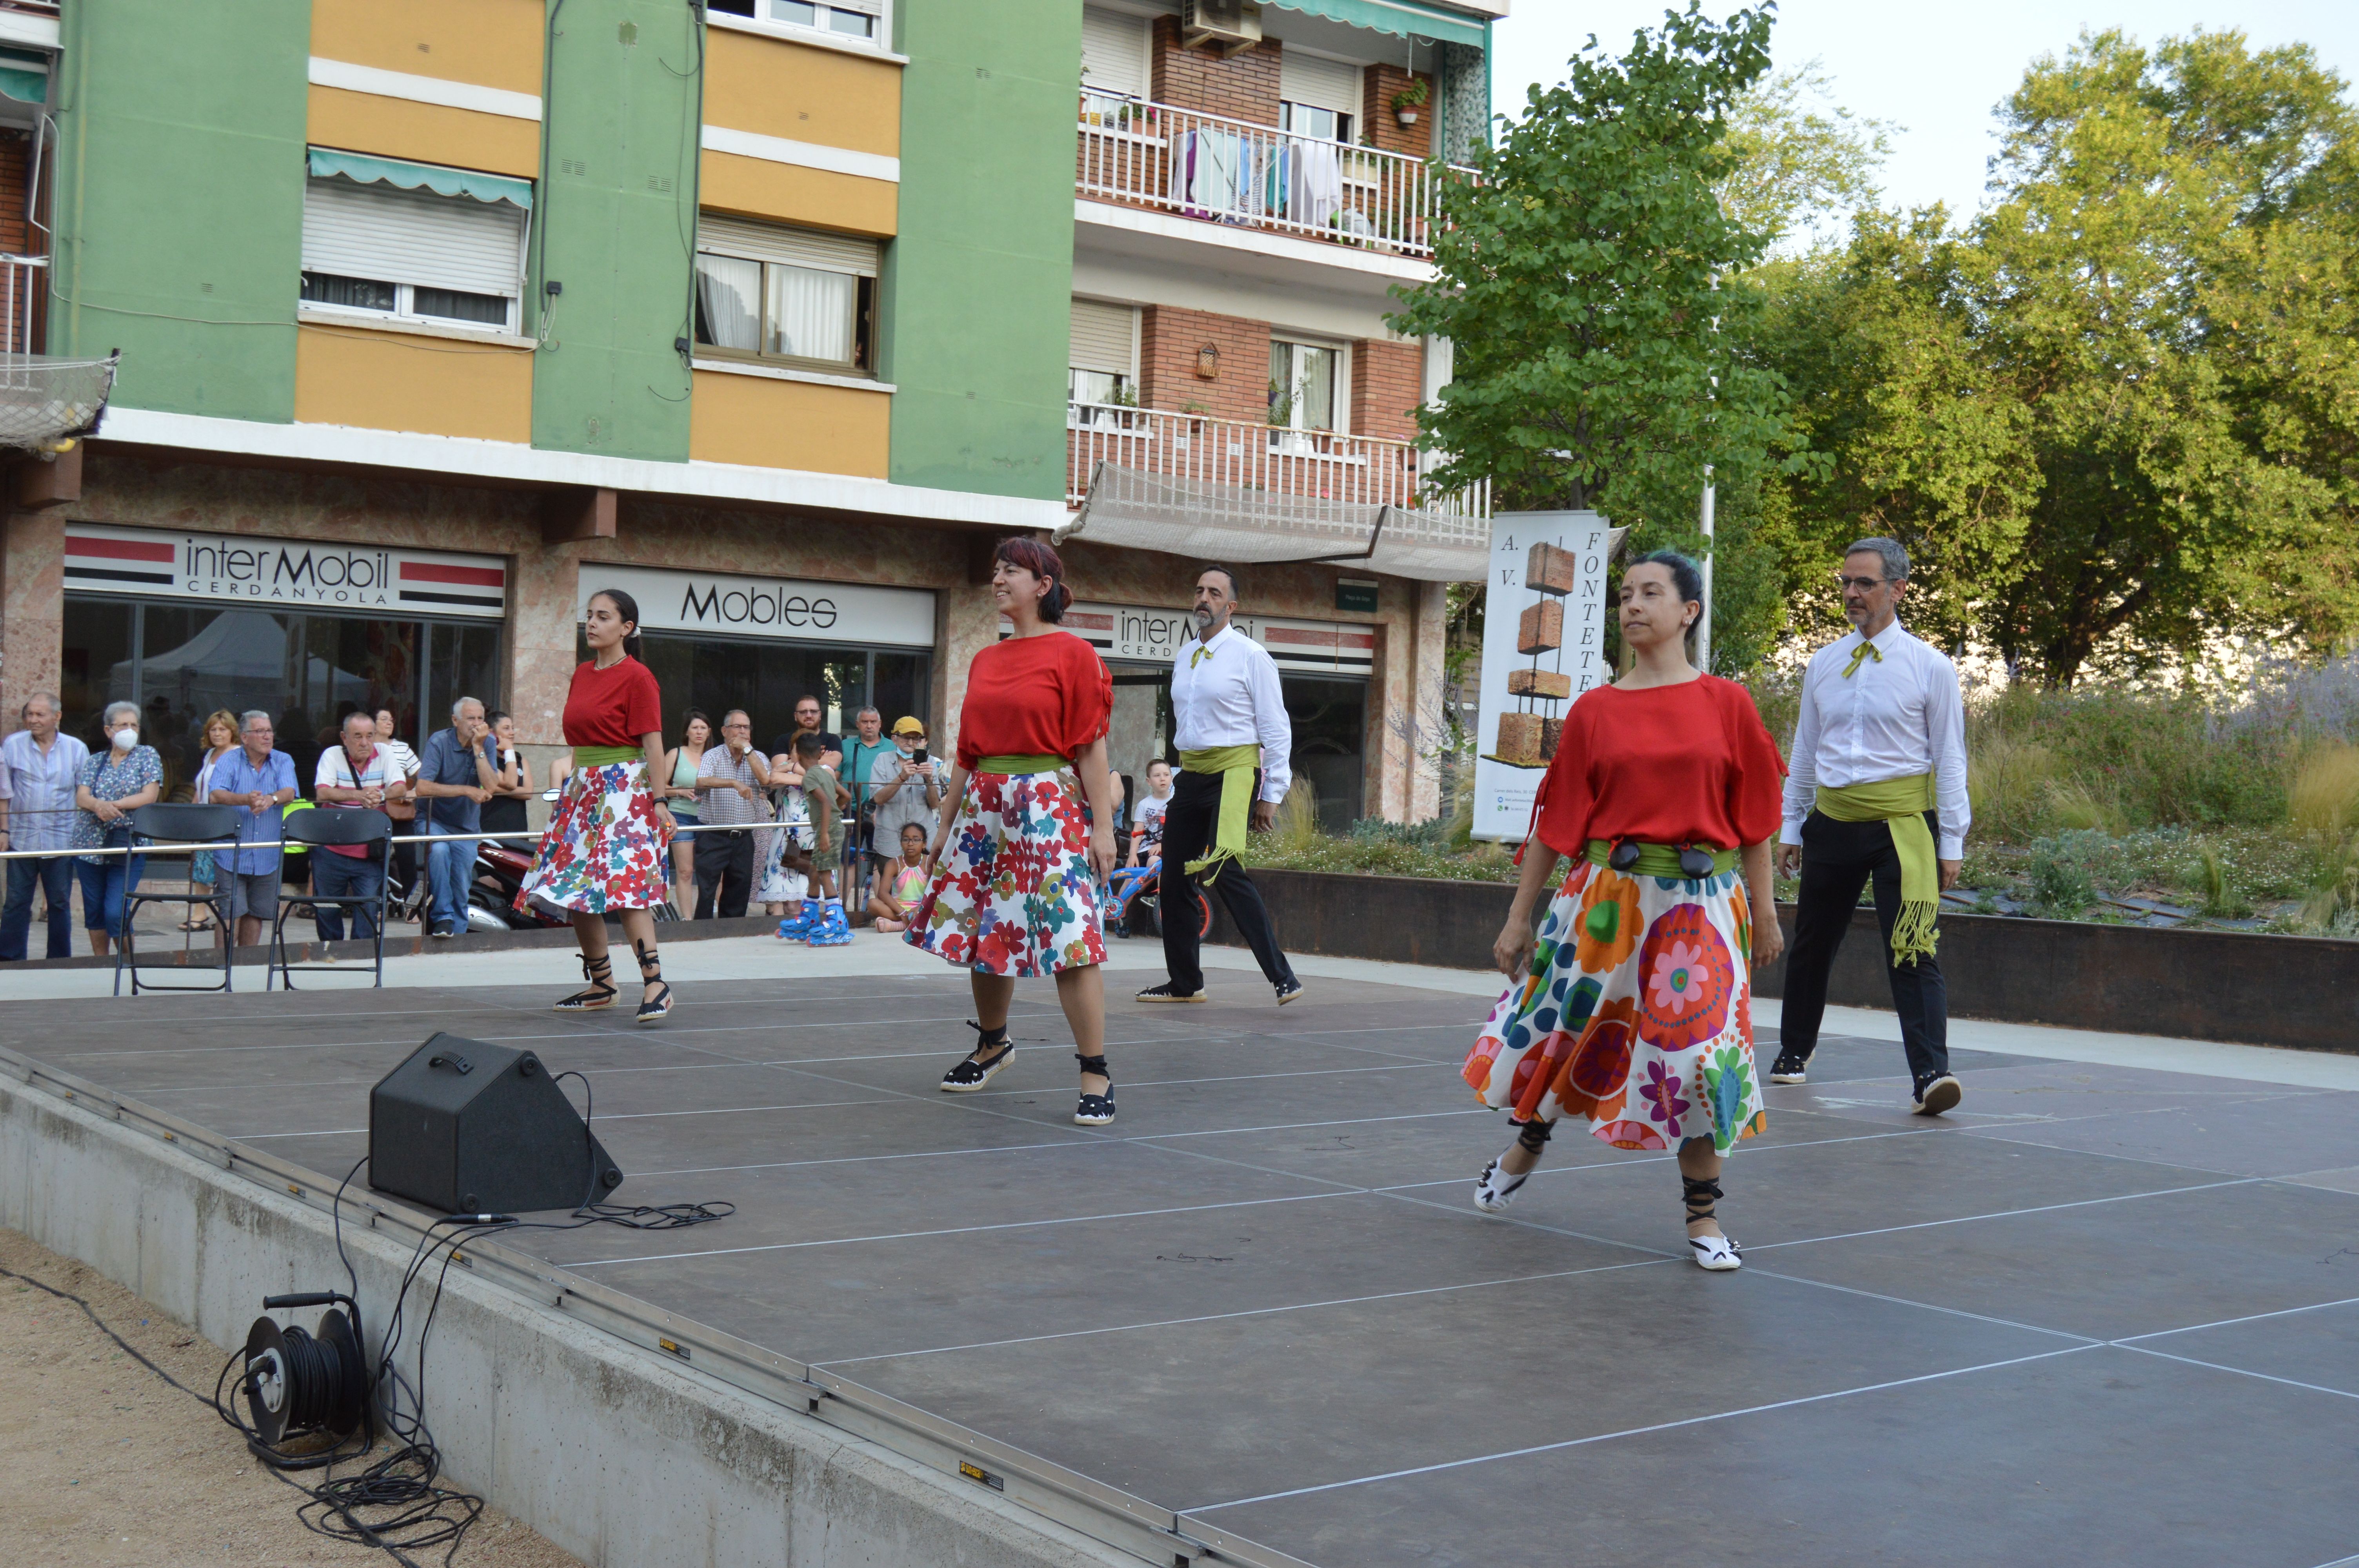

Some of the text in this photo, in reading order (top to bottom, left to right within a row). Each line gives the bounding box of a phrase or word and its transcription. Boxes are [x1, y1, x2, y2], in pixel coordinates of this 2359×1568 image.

[1501, 535, 1518, 550] A.
[1502, 570, 1516, 585] V.
[188, 581, 386, 604] CERDANYOLA
[681, 582, 837, 628] Mobles
[1577, 533, 1601, 692] FONTETE
[1122, 645, 1171, 656] CERD
